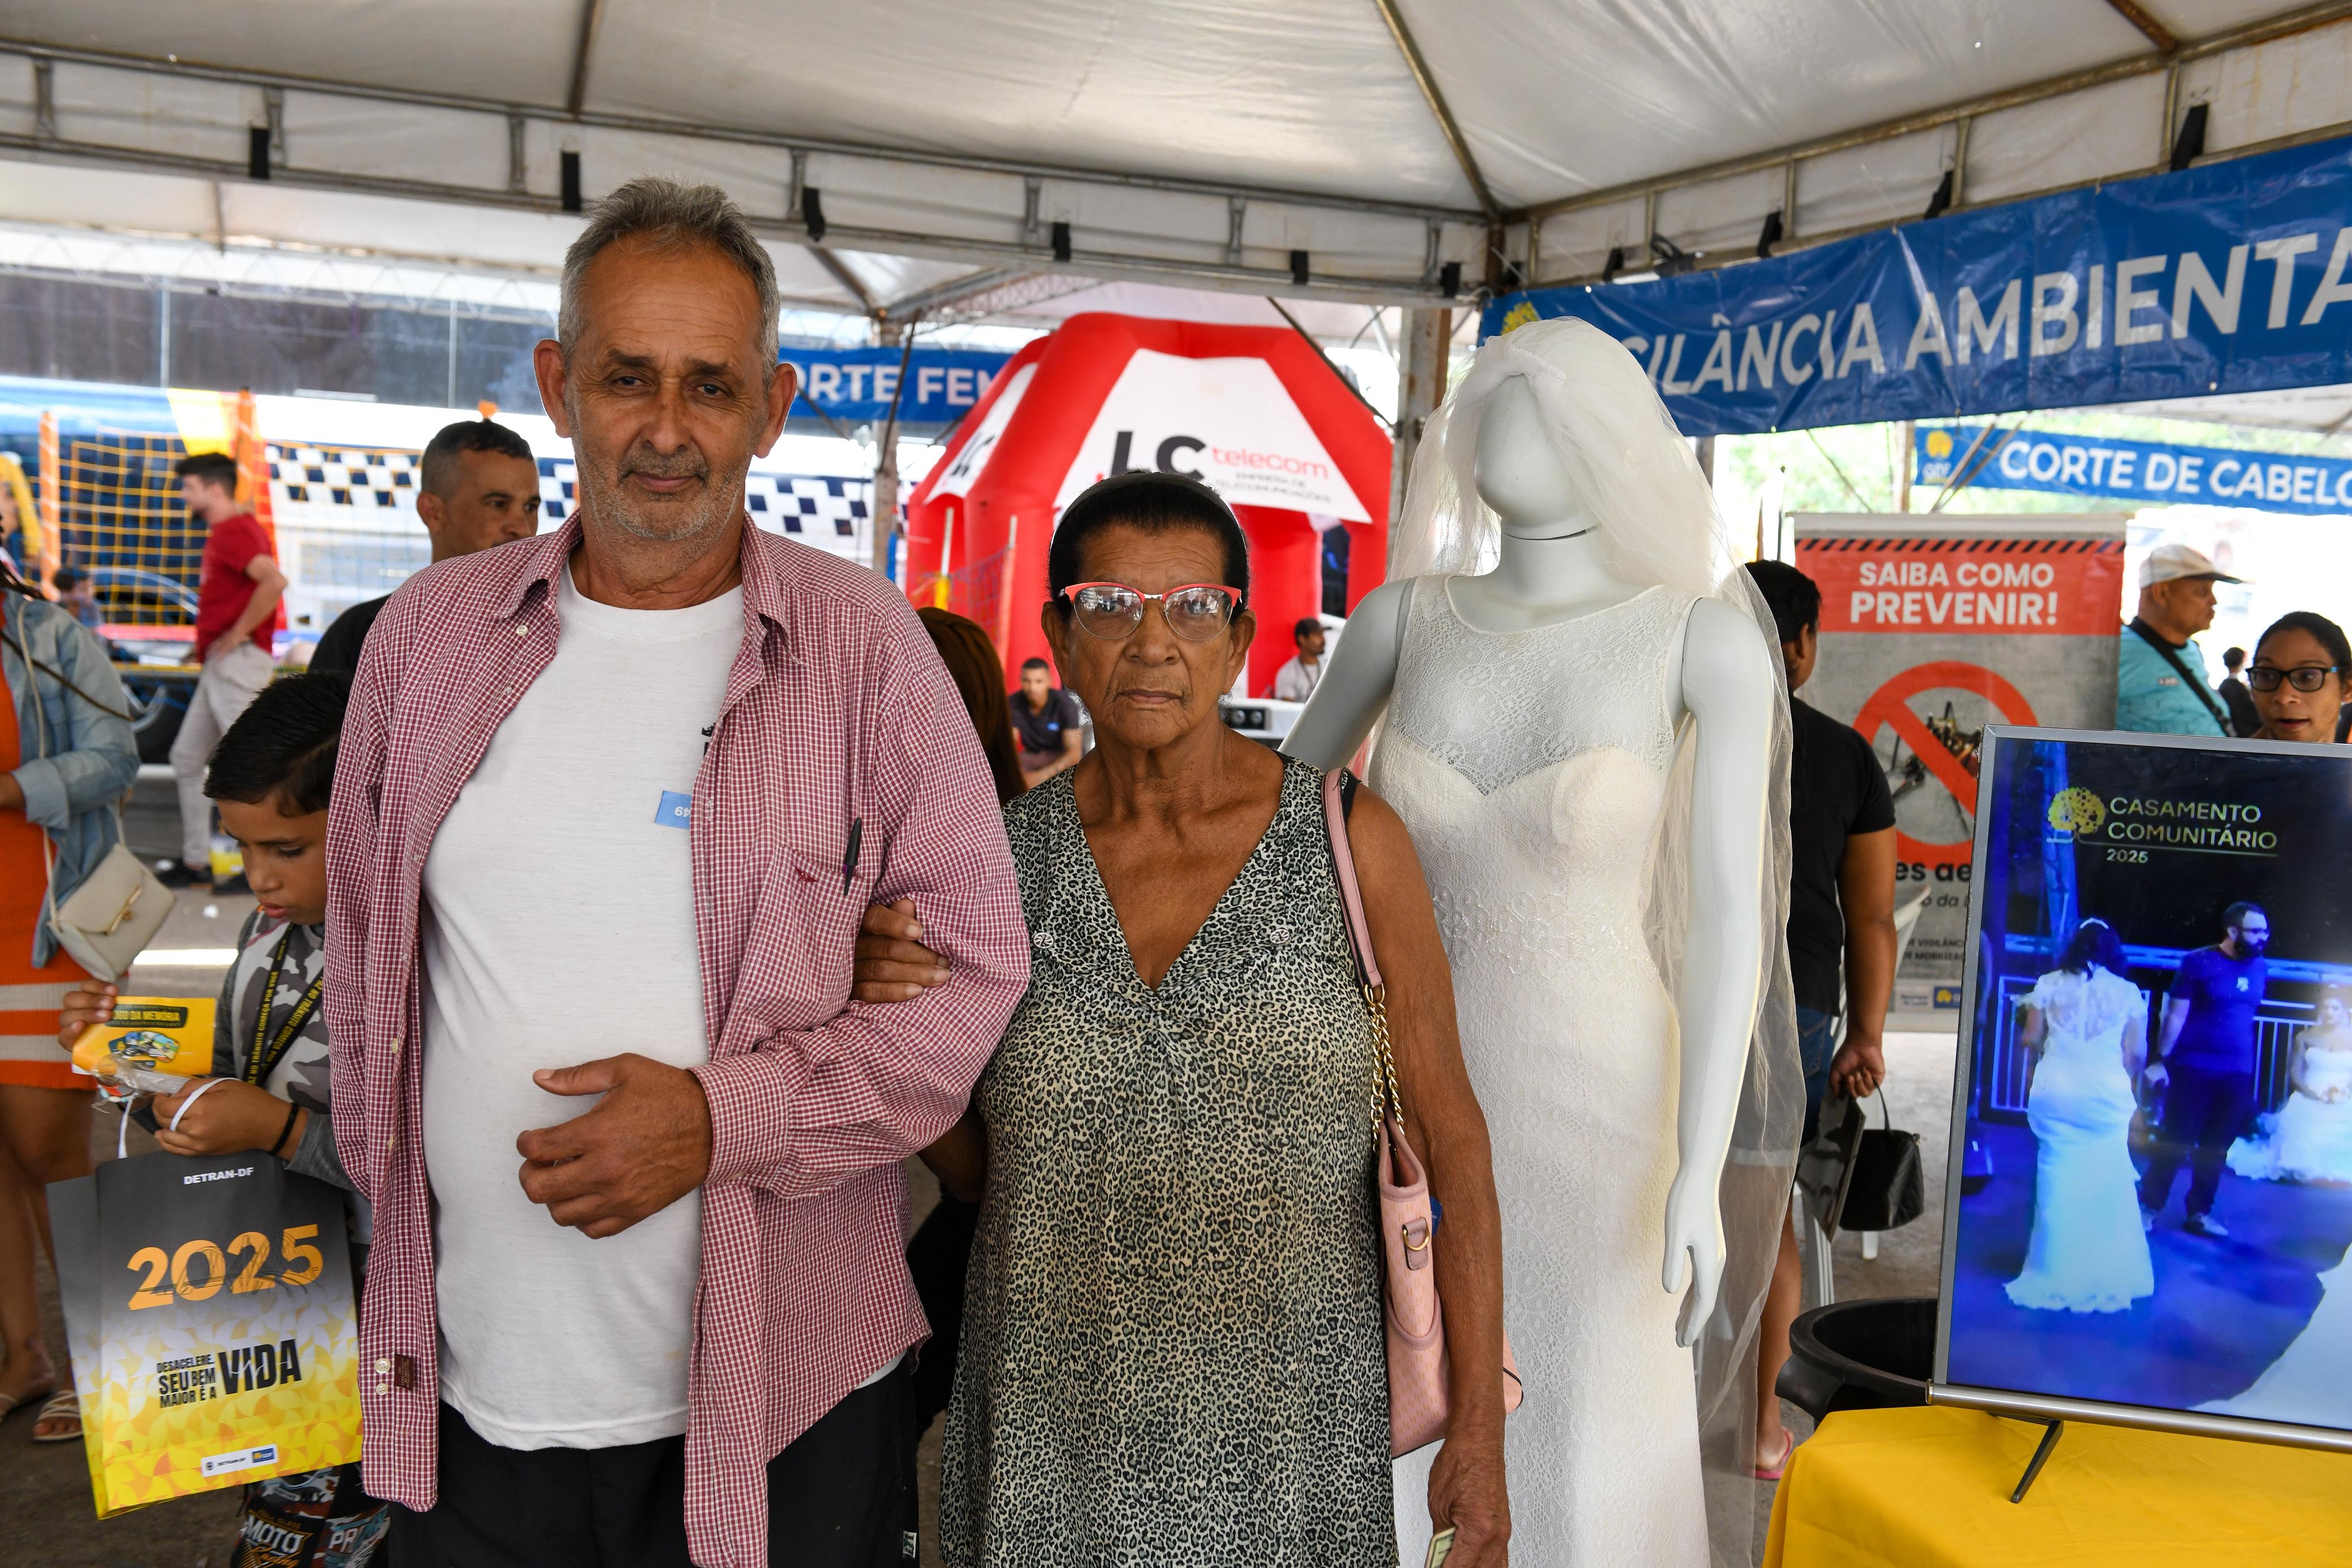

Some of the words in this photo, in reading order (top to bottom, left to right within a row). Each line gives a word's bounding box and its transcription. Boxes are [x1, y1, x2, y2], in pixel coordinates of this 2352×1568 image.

[1213, 445, 1329, 479] telecom
[1999, 440, 2138, 489] CORTE
[2145, 452, 2204, 494] DE
[1858, 562, 1950, 587] SAIBA
[1956, 562, 2055, 588] COMO
[1851, 591, 2059, 626] PREVENIR!
[2109, 797, 2261, 823] CASAMENTO
[2108, 822, 2277, 849] COMUNITÁRIO
[264, 989, 274, 1002] POR
[308, 989, 319, 999] NO
[258, 1003, 271, 1030] COMEÇA
[288, 998, 313, 1026] TRÂNSITO
[183, 1167, 254, 1185] DETRAN-DF
[127, 1223, 323, 1311] 2025
[218, 1339, 302, 1395] VIDA
[159, 1371, 189, 1395] SEU
[192, 1367, 216, 1387] BEM
[160, 1390, 196, 1408] MAIOR
[200, 1385, 206, 1401] É
[210, 1386, 217, 1399] A
[245, 1513, 305, 1554] MOTO
